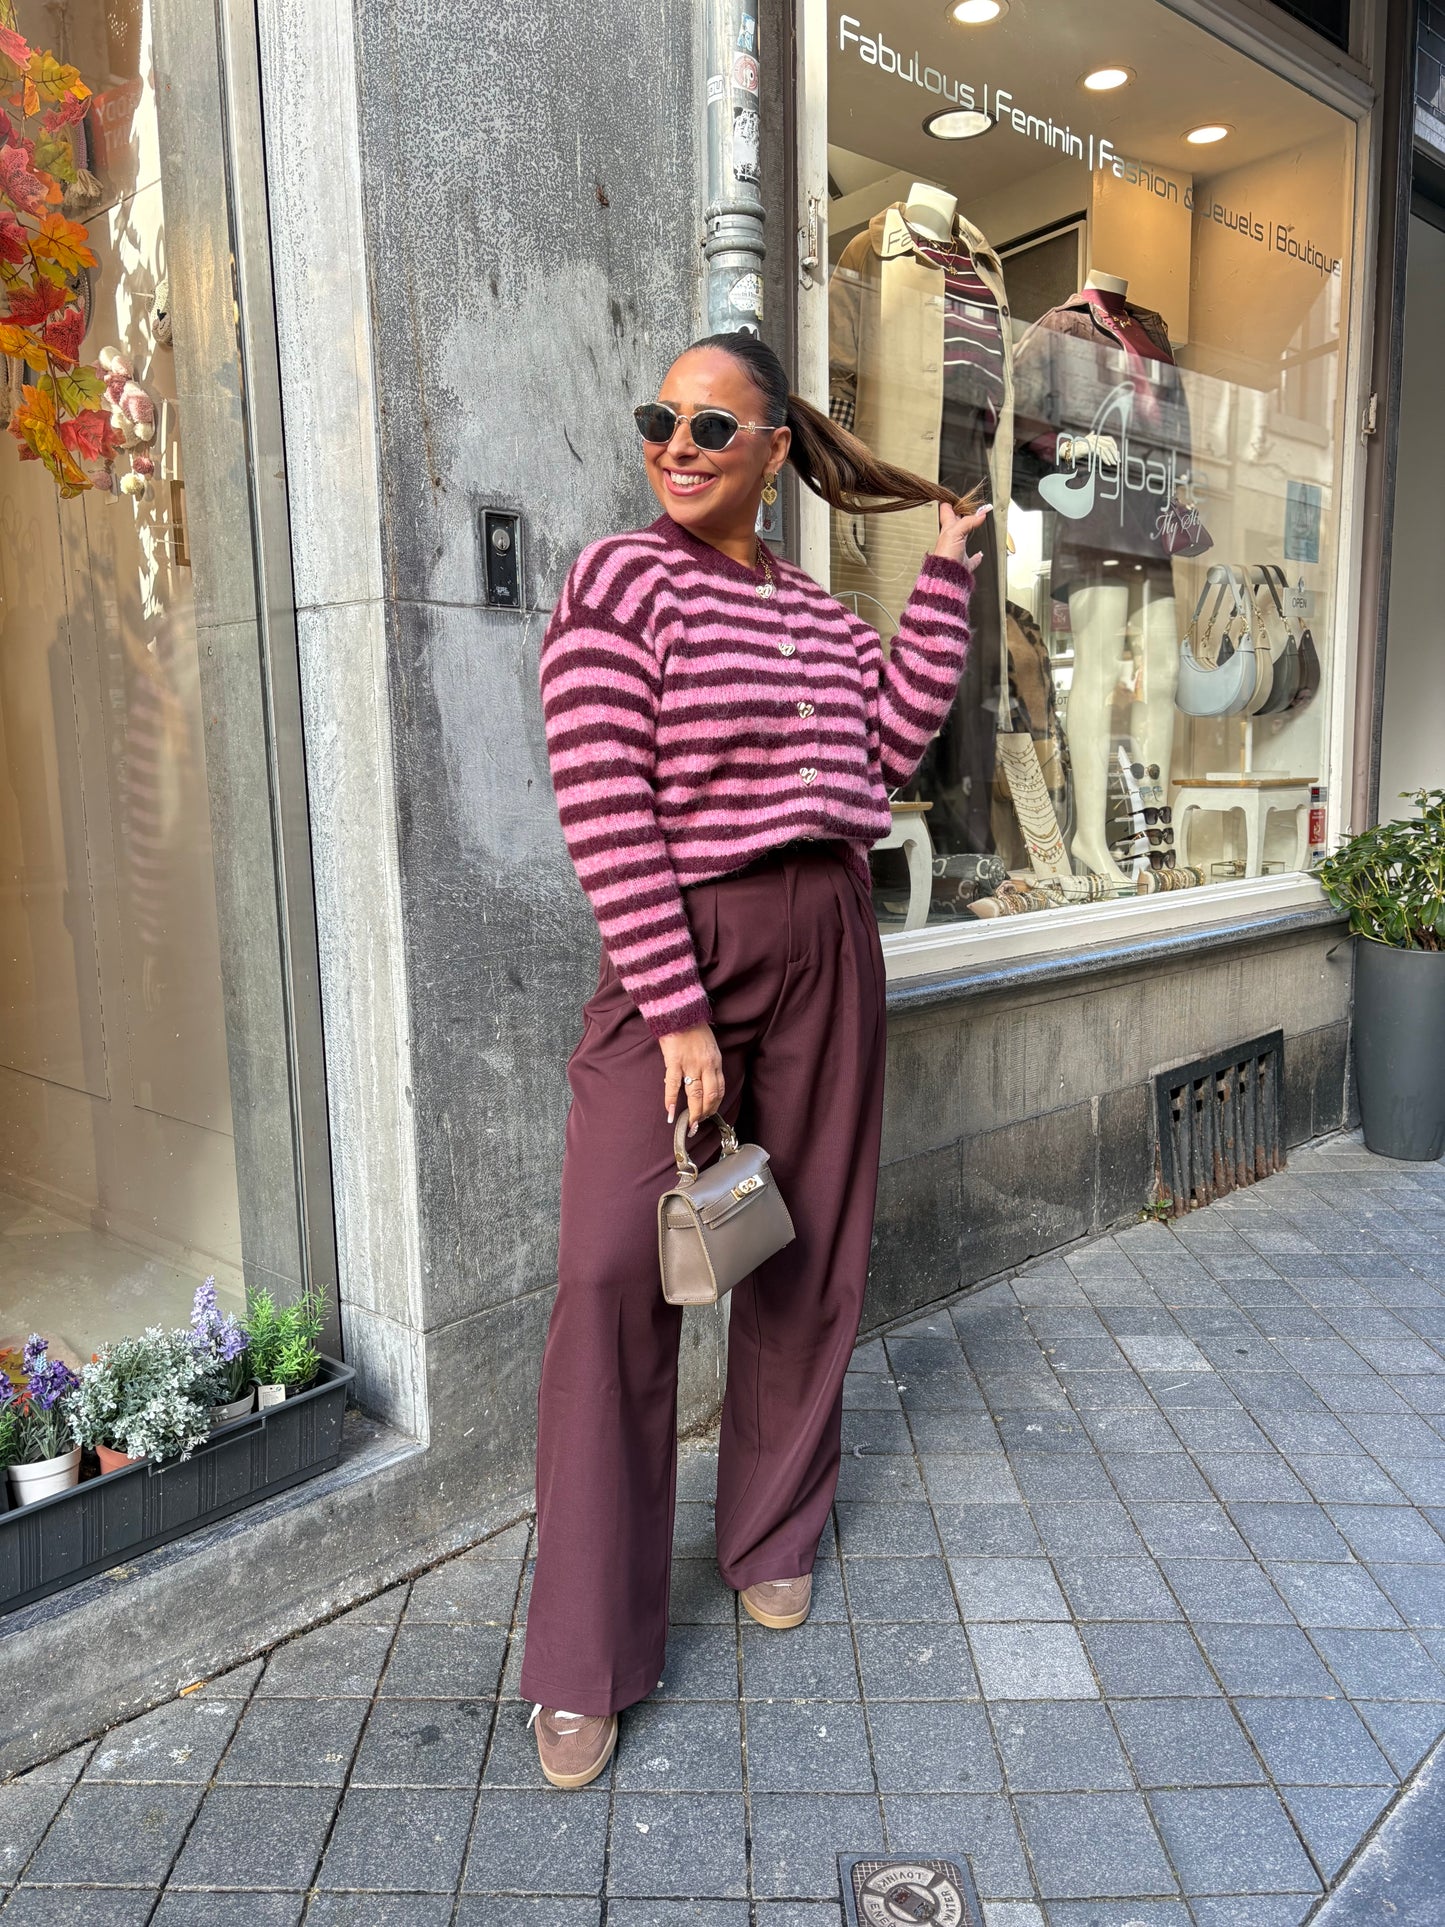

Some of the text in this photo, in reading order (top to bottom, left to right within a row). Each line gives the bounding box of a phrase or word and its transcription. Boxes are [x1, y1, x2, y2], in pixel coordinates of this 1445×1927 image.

[839, 14, 976, 110] Fabulous
[995, 89, 1084, 162] Feminin
[1098, 139, 1178, 204] Fashion
[1184, 186, 1195, 213] &
[1200, 192, 1264, 242] Jewels
[1275, 224, 1341, 278] Boutique
[1291, 597, 1308, 609] OPEN
[881, 1871, 923, 1887] LOVINK
